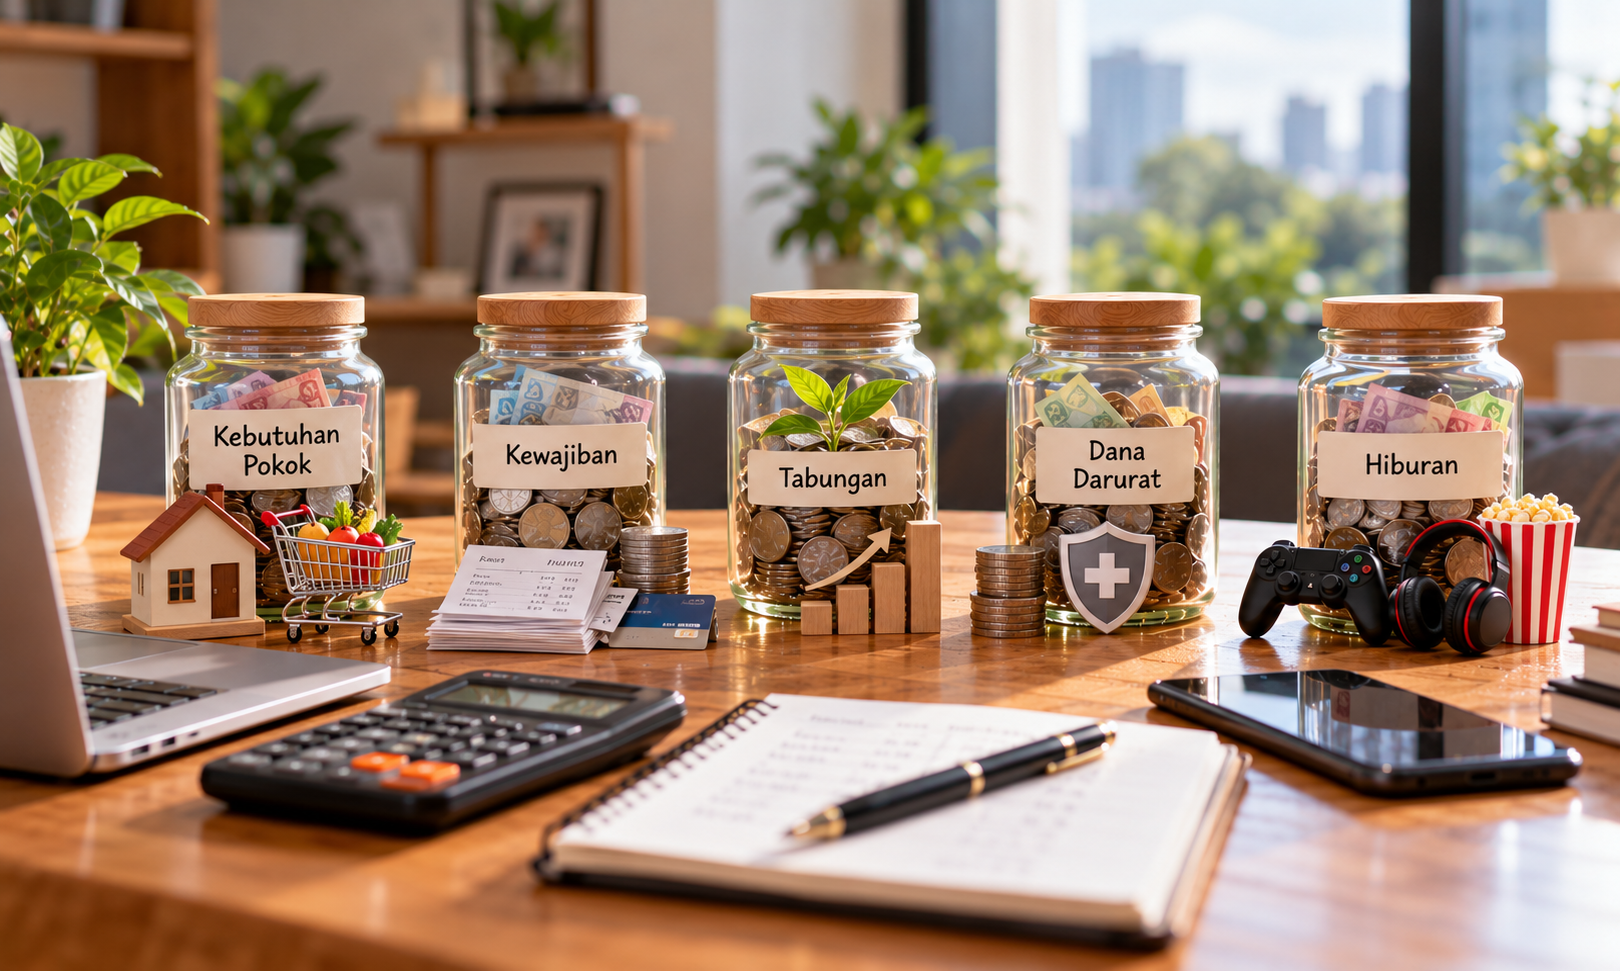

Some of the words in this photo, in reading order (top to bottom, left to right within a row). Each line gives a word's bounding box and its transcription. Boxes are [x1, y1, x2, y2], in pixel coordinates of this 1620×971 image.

[215, 423, 339, 447] Kebutuhan
[507, 443, 617, 472] Kewajiban
[1089, 440, 1145, 461] Dana
[243, 453, 311, 477] Pokok
[1366, 453, 1458, 476] Hiburan
[779, 466, 886, 495] Tabungan
[1074, 468, 1161, 490] Darurat
